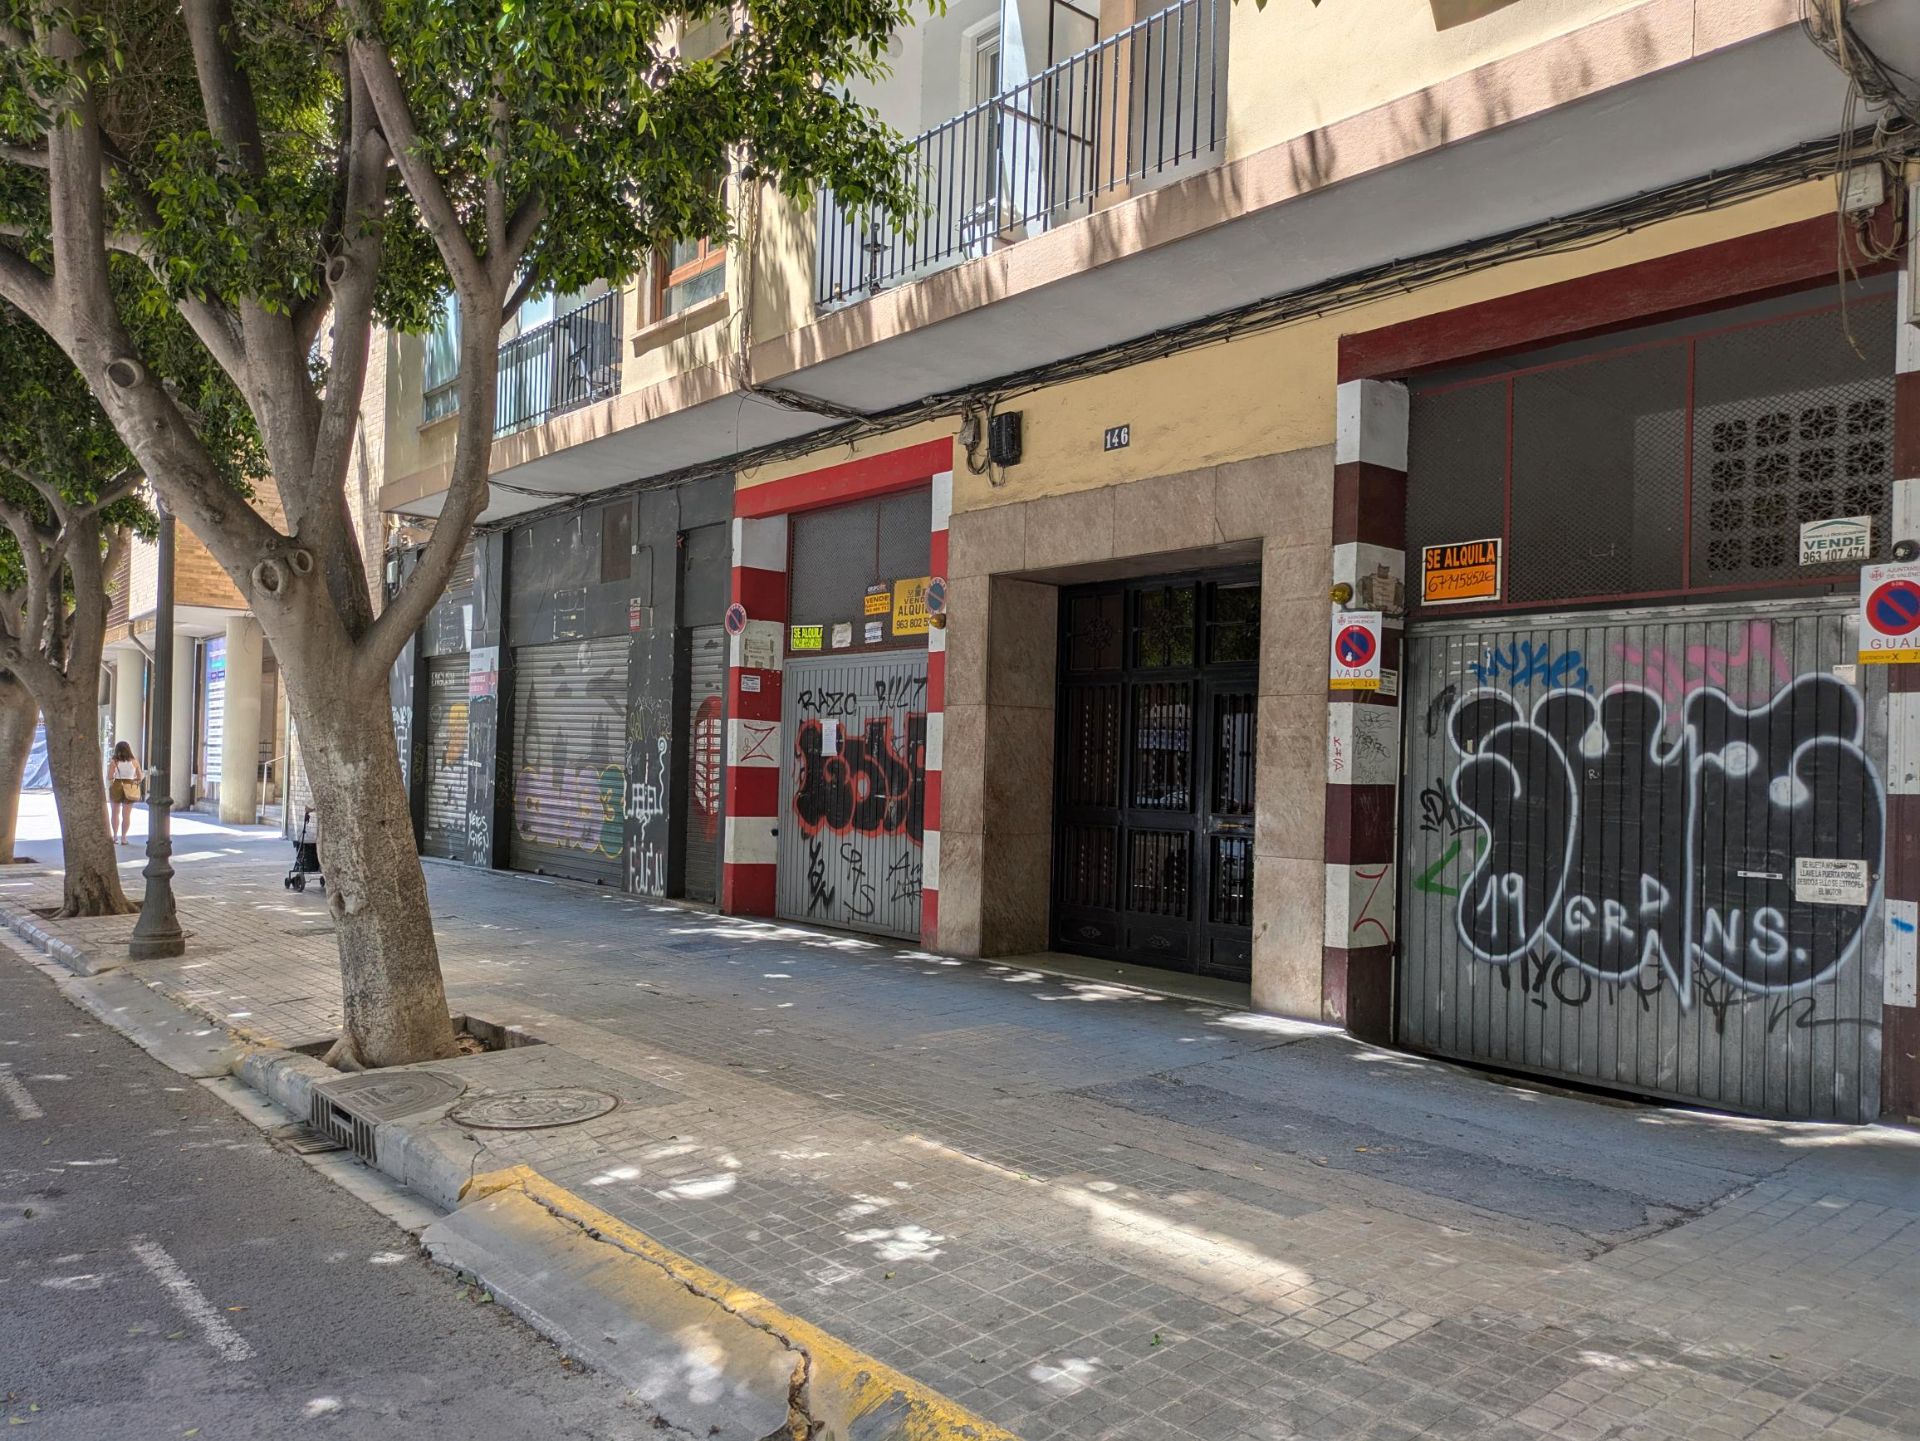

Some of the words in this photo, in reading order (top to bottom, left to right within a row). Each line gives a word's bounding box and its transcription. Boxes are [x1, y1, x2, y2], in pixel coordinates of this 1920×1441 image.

[1106, 427, 1128, 449] 146
[1804, 536, 1866, 550] VENDE
[1426, 549, 1441, 569] SE
[1444, 543, 1496, 568] ALQUILA
[1803, 551, 1822, 564] 963
[1825, 548, 1843, 561] 107
[1846, 546, 1865, 559] 471
[896, 619, 909, 629] 963
[1336, 669, 1374, 678] VADO
